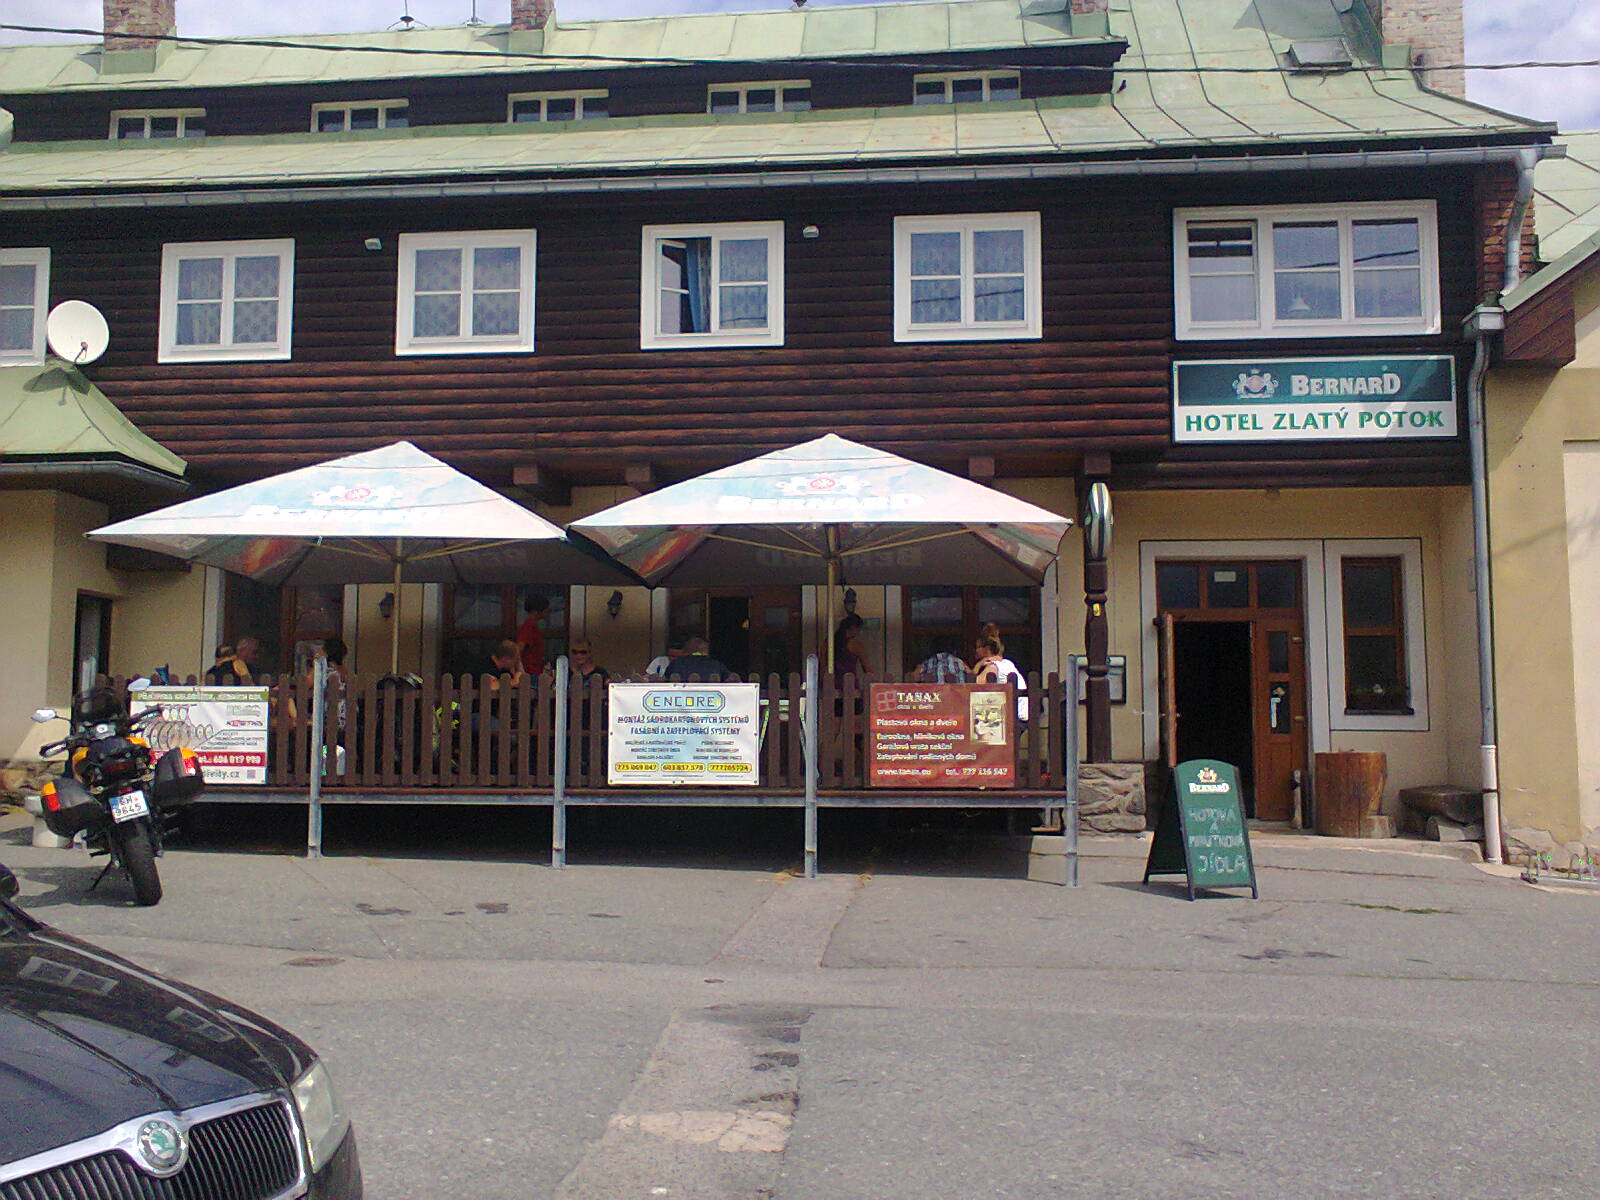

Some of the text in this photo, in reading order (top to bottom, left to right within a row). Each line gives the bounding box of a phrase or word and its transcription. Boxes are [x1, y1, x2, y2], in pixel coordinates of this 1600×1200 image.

[1290, 373, 1401, 396] BERNARD
[1186, 407, 1445, 432] HOTEL ZLATÝ POTOK
[653, 696, 715, 707] ENCORE
[897, 692, 942, 703] TANAX
[1188, 783, 1231, 793] BERNARD
